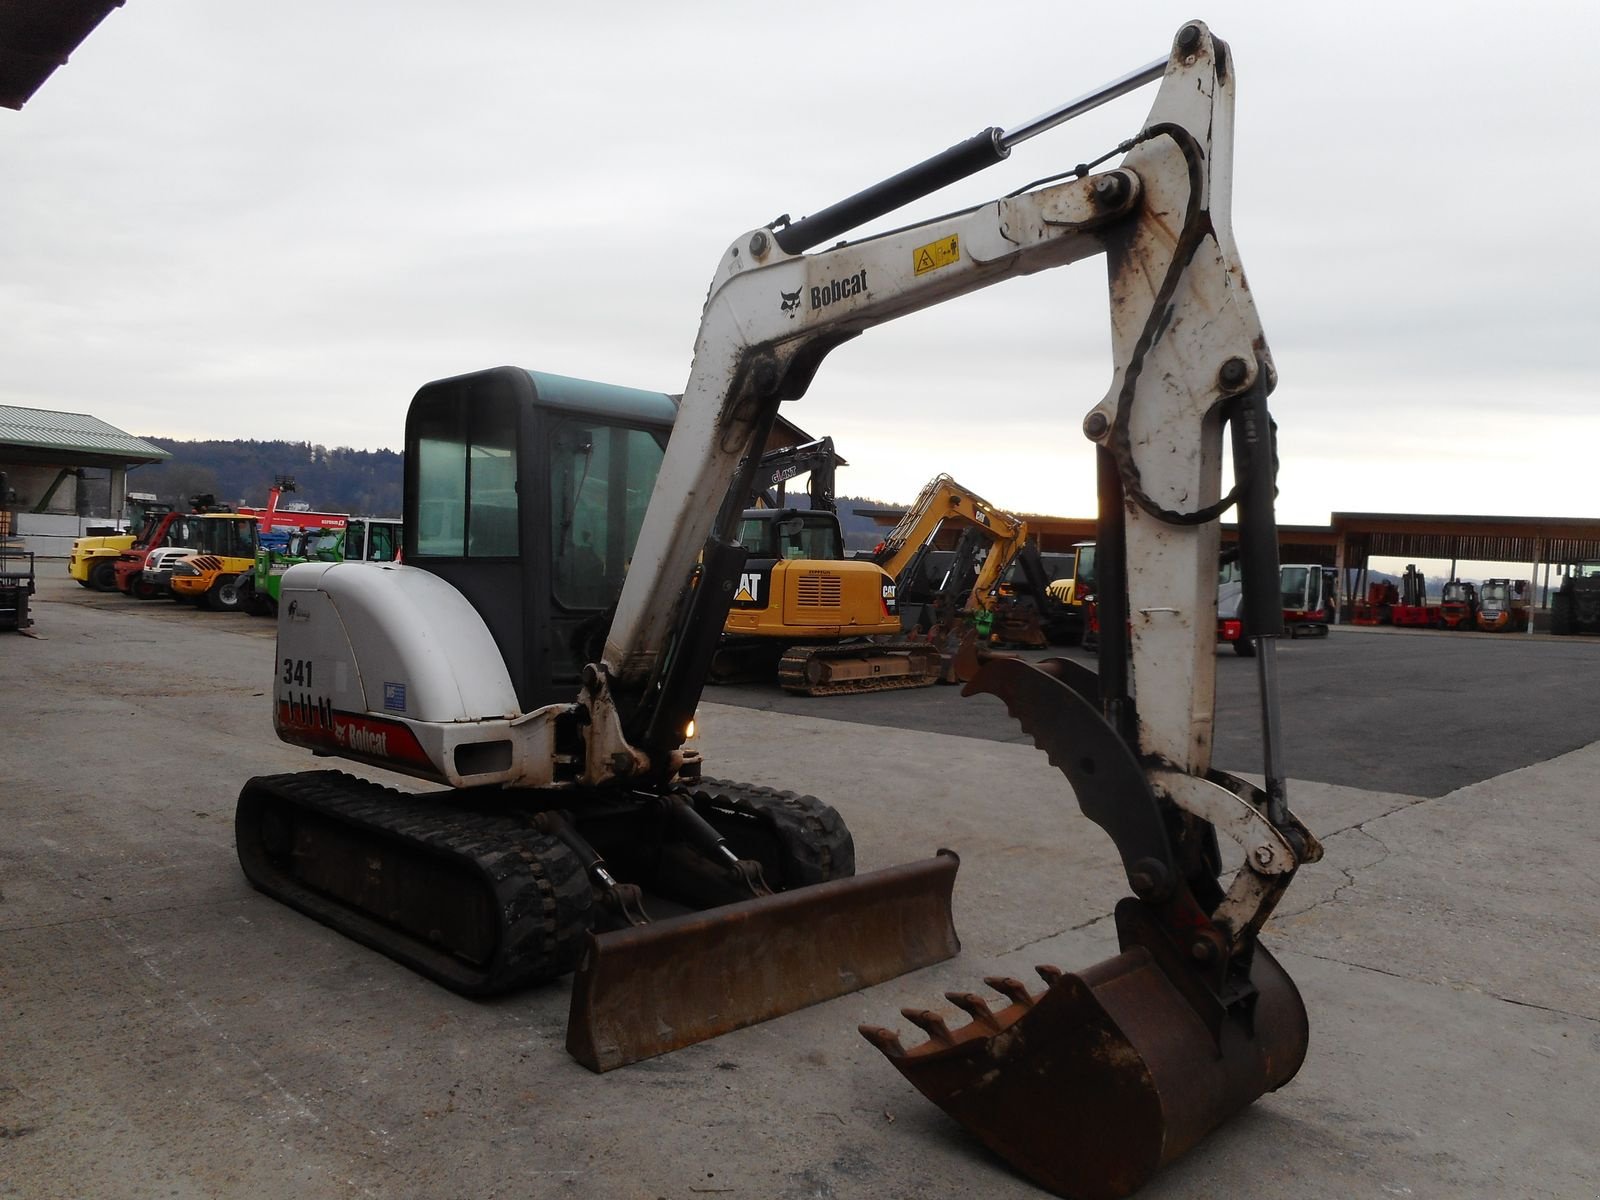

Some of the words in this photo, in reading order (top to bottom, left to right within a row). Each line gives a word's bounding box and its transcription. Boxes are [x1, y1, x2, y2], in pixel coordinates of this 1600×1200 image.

[811, 269, 868, 310] Bobcat
[733, 573, 761, 601] AT
[883, 585, 896, 598] CAT
[283, 659, 312, 688] 341
[349, 723, 388, 757] Bobcat
